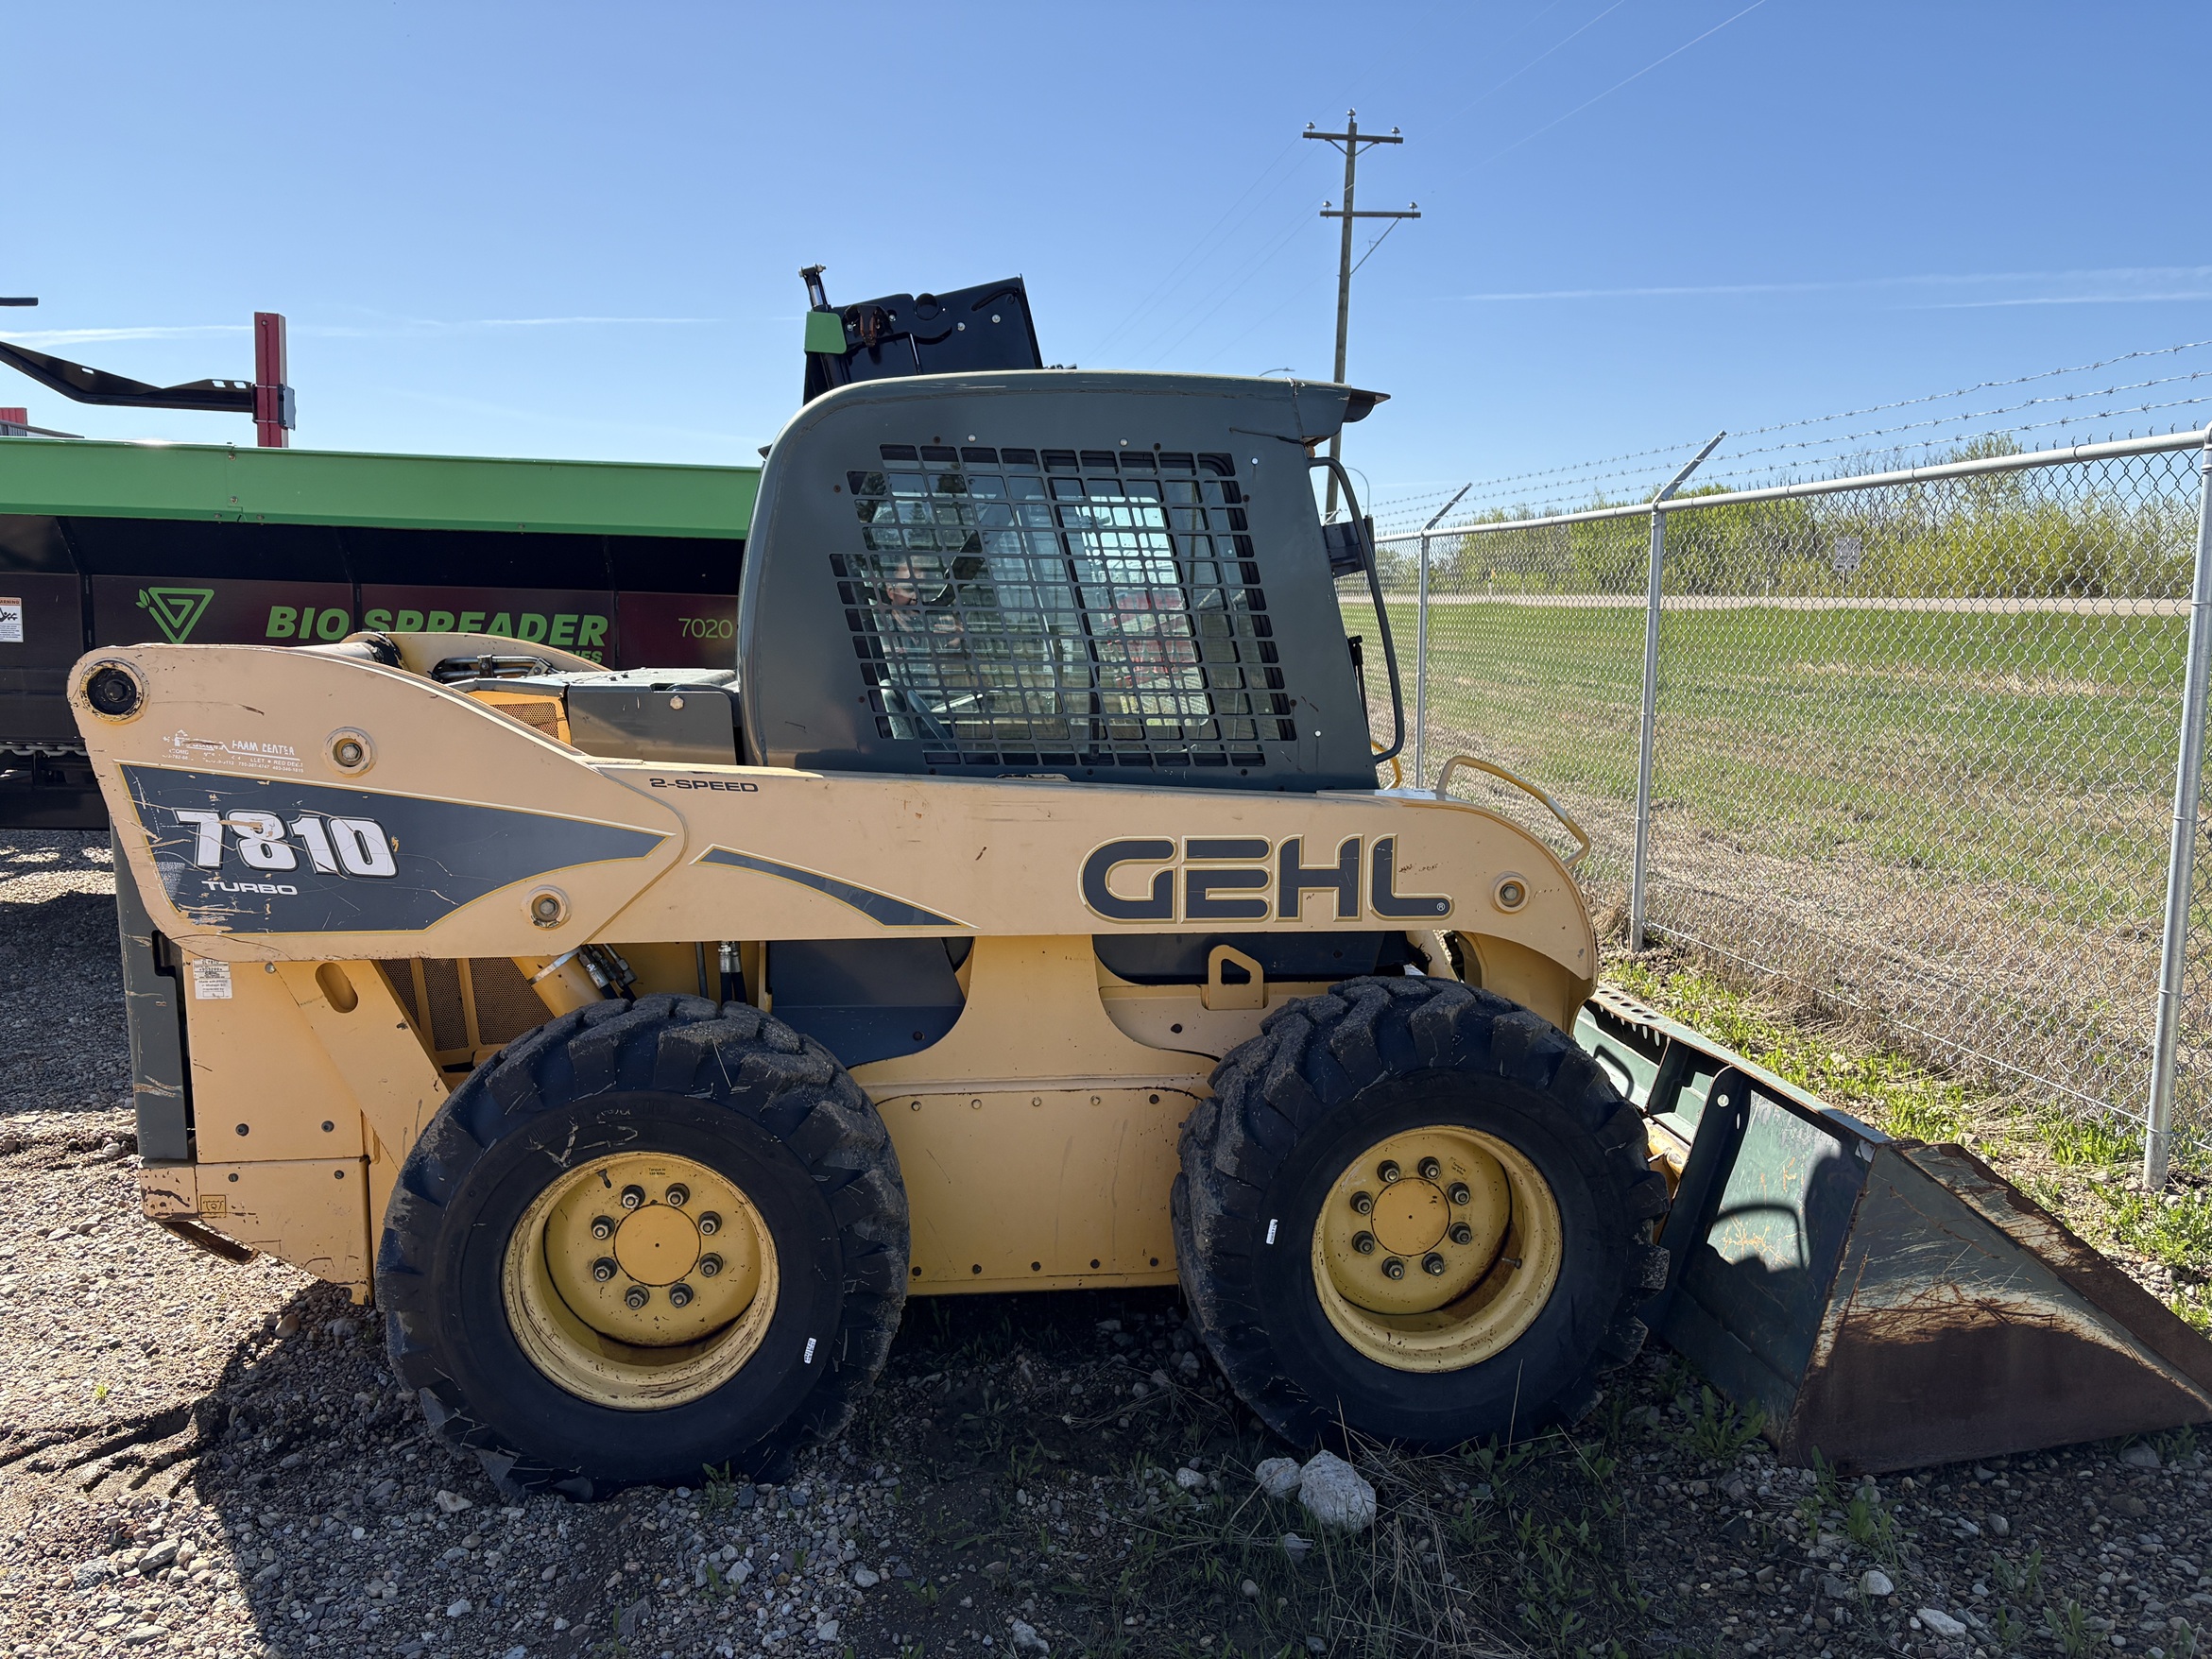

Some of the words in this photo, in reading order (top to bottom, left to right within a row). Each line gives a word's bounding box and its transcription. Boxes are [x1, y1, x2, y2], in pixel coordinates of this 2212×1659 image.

[266, 606, 350, 641] BIO
[362, 608, 609, 647] SPREADER
[677, 617, 733, 639] 7020
[649, 778, 759, 793] 2-SPEED
[171, 807, 399, 879] 7810
[201, 881, 299, 896] TURBO
[1077, 833, 1455, 924] GEHL
